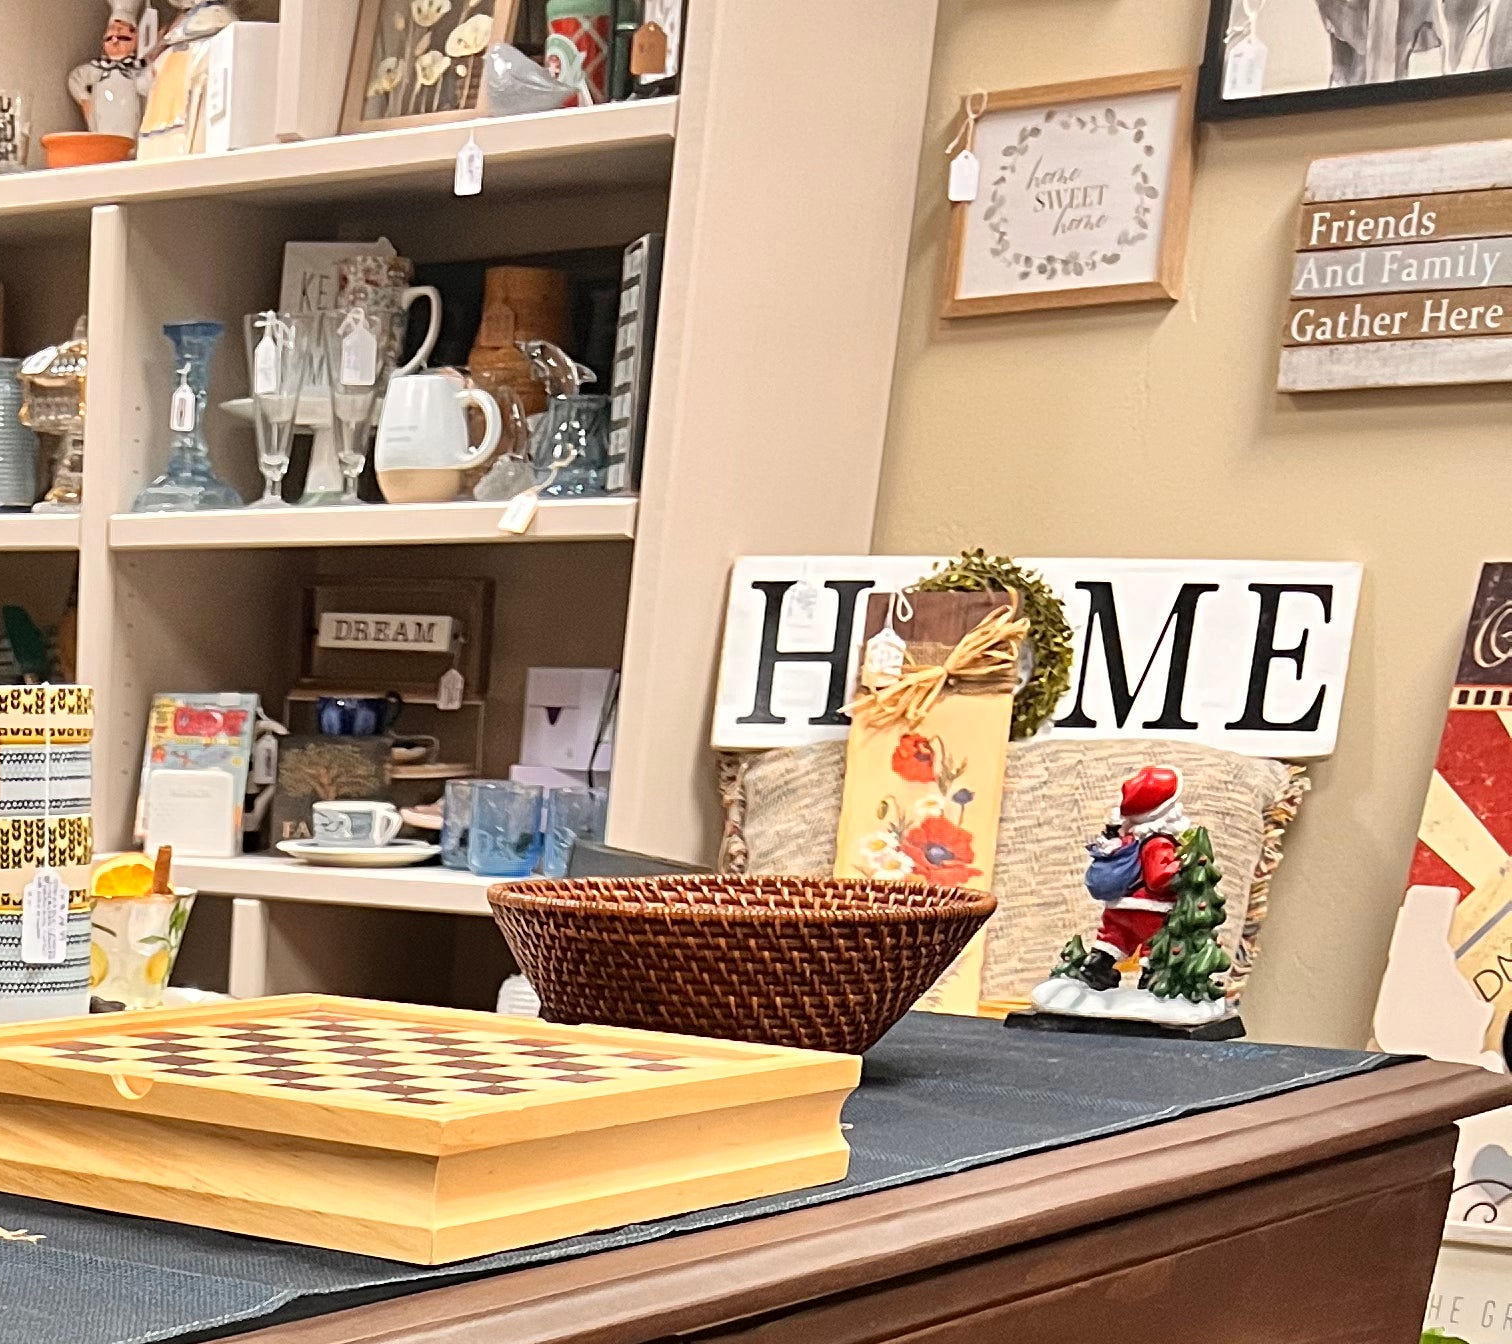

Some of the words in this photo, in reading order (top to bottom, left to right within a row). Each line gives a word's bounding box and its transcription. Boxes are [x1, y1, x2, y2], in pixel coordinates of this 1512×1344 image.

[1026, 154, 1082, 190] home
[1032, 184, 1110, 213] SWEET
[1052, 204, 1111, 236] home
[1309, 201, 1437, 246] Friends
[1295, 251, 1367, 290] And
[1381, 243, 1502, 287] Family
[1290, 303, 1409, 342] Gather
[1420, 298, 1504, 333] Here
[334, 619, 436, 643] DREAM
[736, 580, 1335, 731] HME
